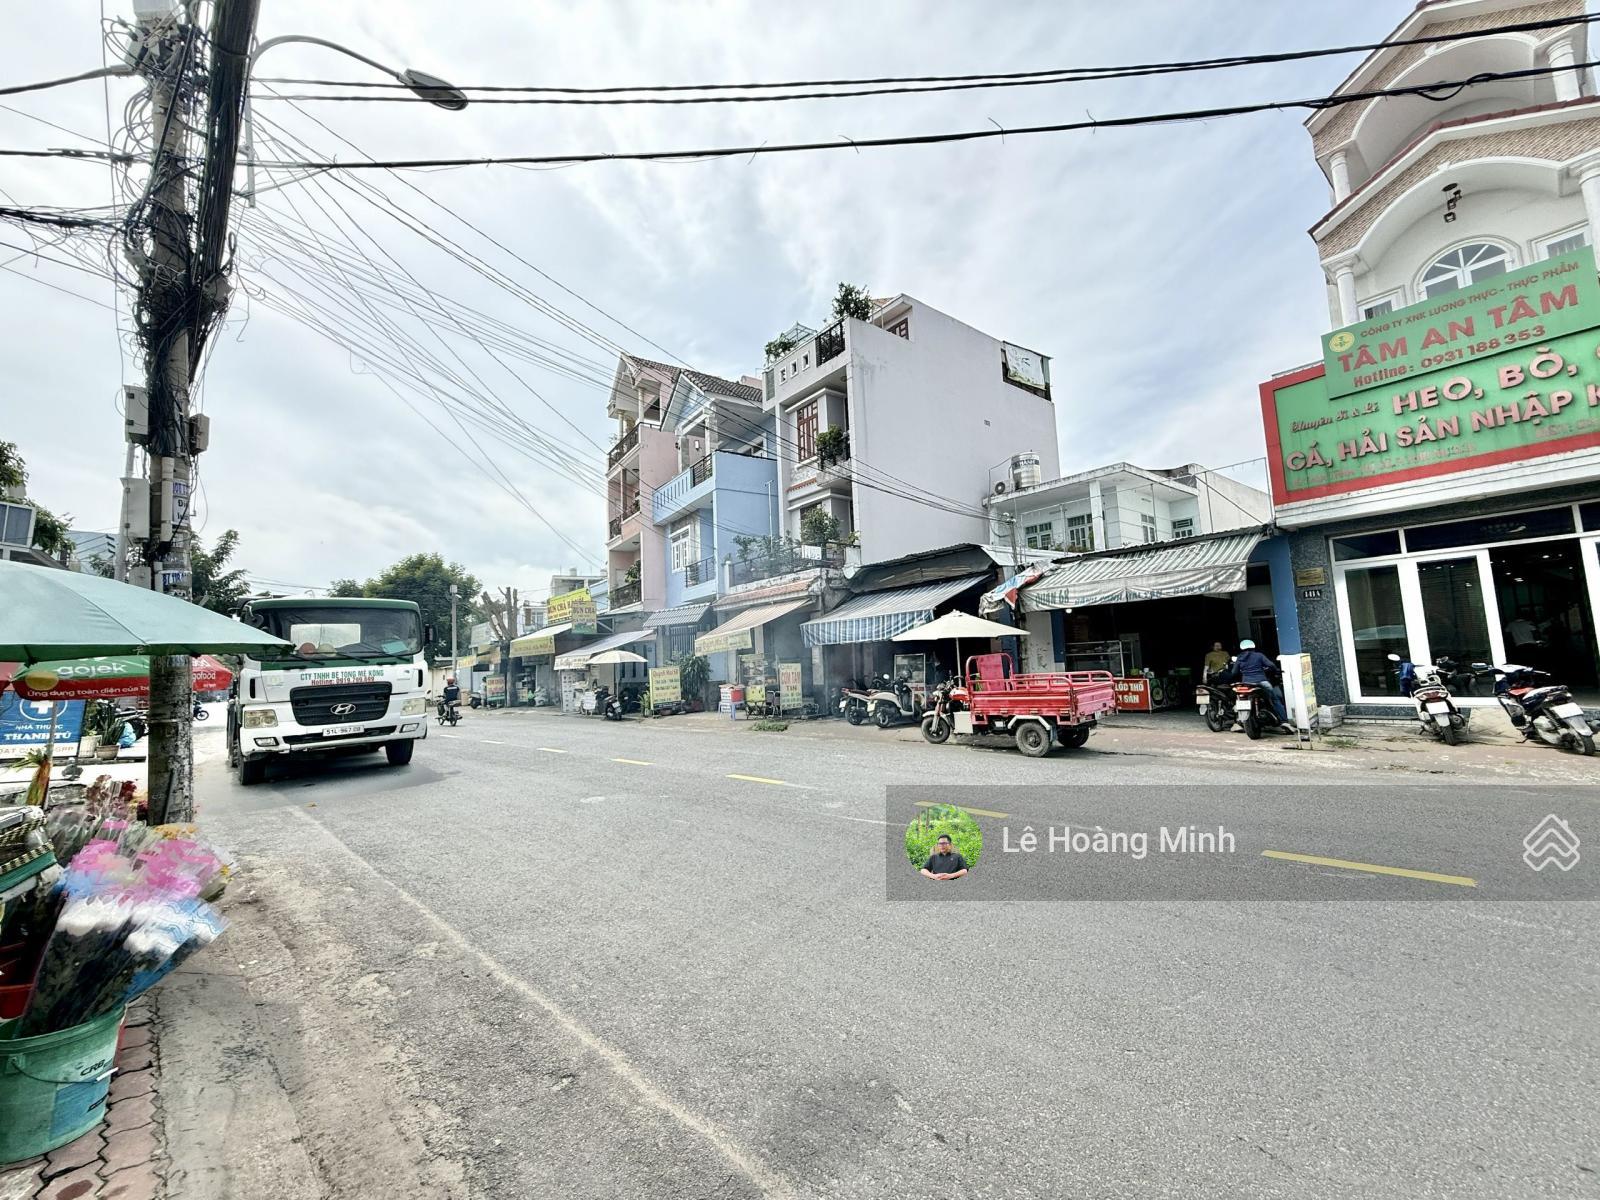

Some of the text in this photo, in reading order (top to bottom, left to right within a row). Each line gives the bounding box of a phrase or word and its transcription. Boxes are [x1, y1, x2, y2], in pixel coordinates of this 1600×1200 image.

[1338, 284, 1579, 373] TÂM AN TÂM
[1389, 319, 1402, 331] TY
[1392, 346, 1578, 416] HEO, BÒ,
[1286, 440, 1333, 472] CÁ,
[1338, 428, 1389, 462] HẢI
[1395, 413, 1461, 447] SẢN
[1471, 390, 1574, 433] NHẬP
[1059, 588, 1069, 604] 68
[56, 662, 127, 678] gojek
